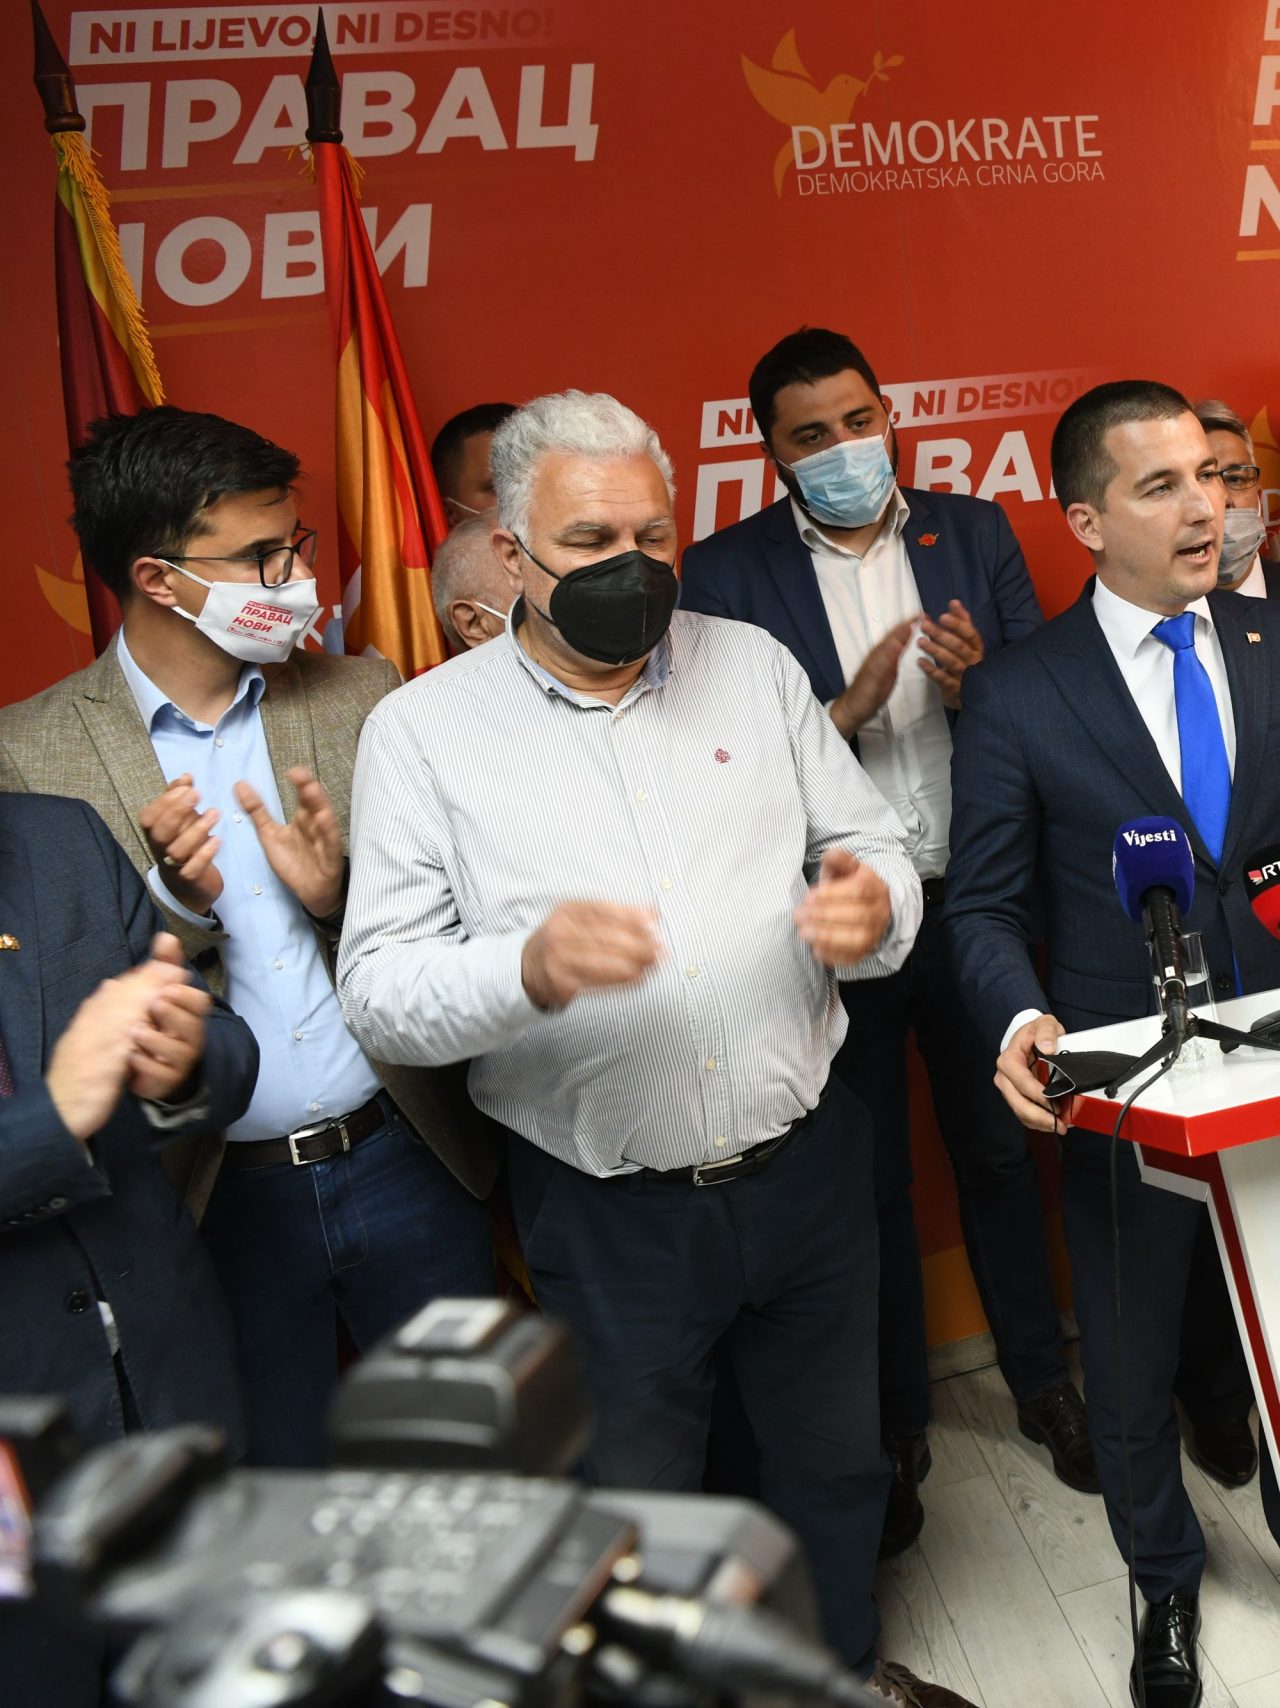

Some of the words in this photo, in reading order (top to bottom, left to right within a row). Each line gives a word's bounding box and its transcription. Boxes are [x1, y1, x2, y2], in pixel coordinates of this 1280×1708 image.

[90, 21, 137, 54] NI
[336, 13, 381, 45] NI
[791, 114, 1103, 170] DEMOKRATE
[797, 167, 970, 196] DEMOKRATSKA
[976, 164, 1038, 186] CRNA
[1043, 161, 1105, 183] GORA
[912, 389, 946, 417] NI
[717, 407, 754, 437] NI
[232, 616, 273, 633] НОВИ
[241, 606, 294, 626] ПРАВАЦ
[1123, 829, 1177, 847] Vijesti
